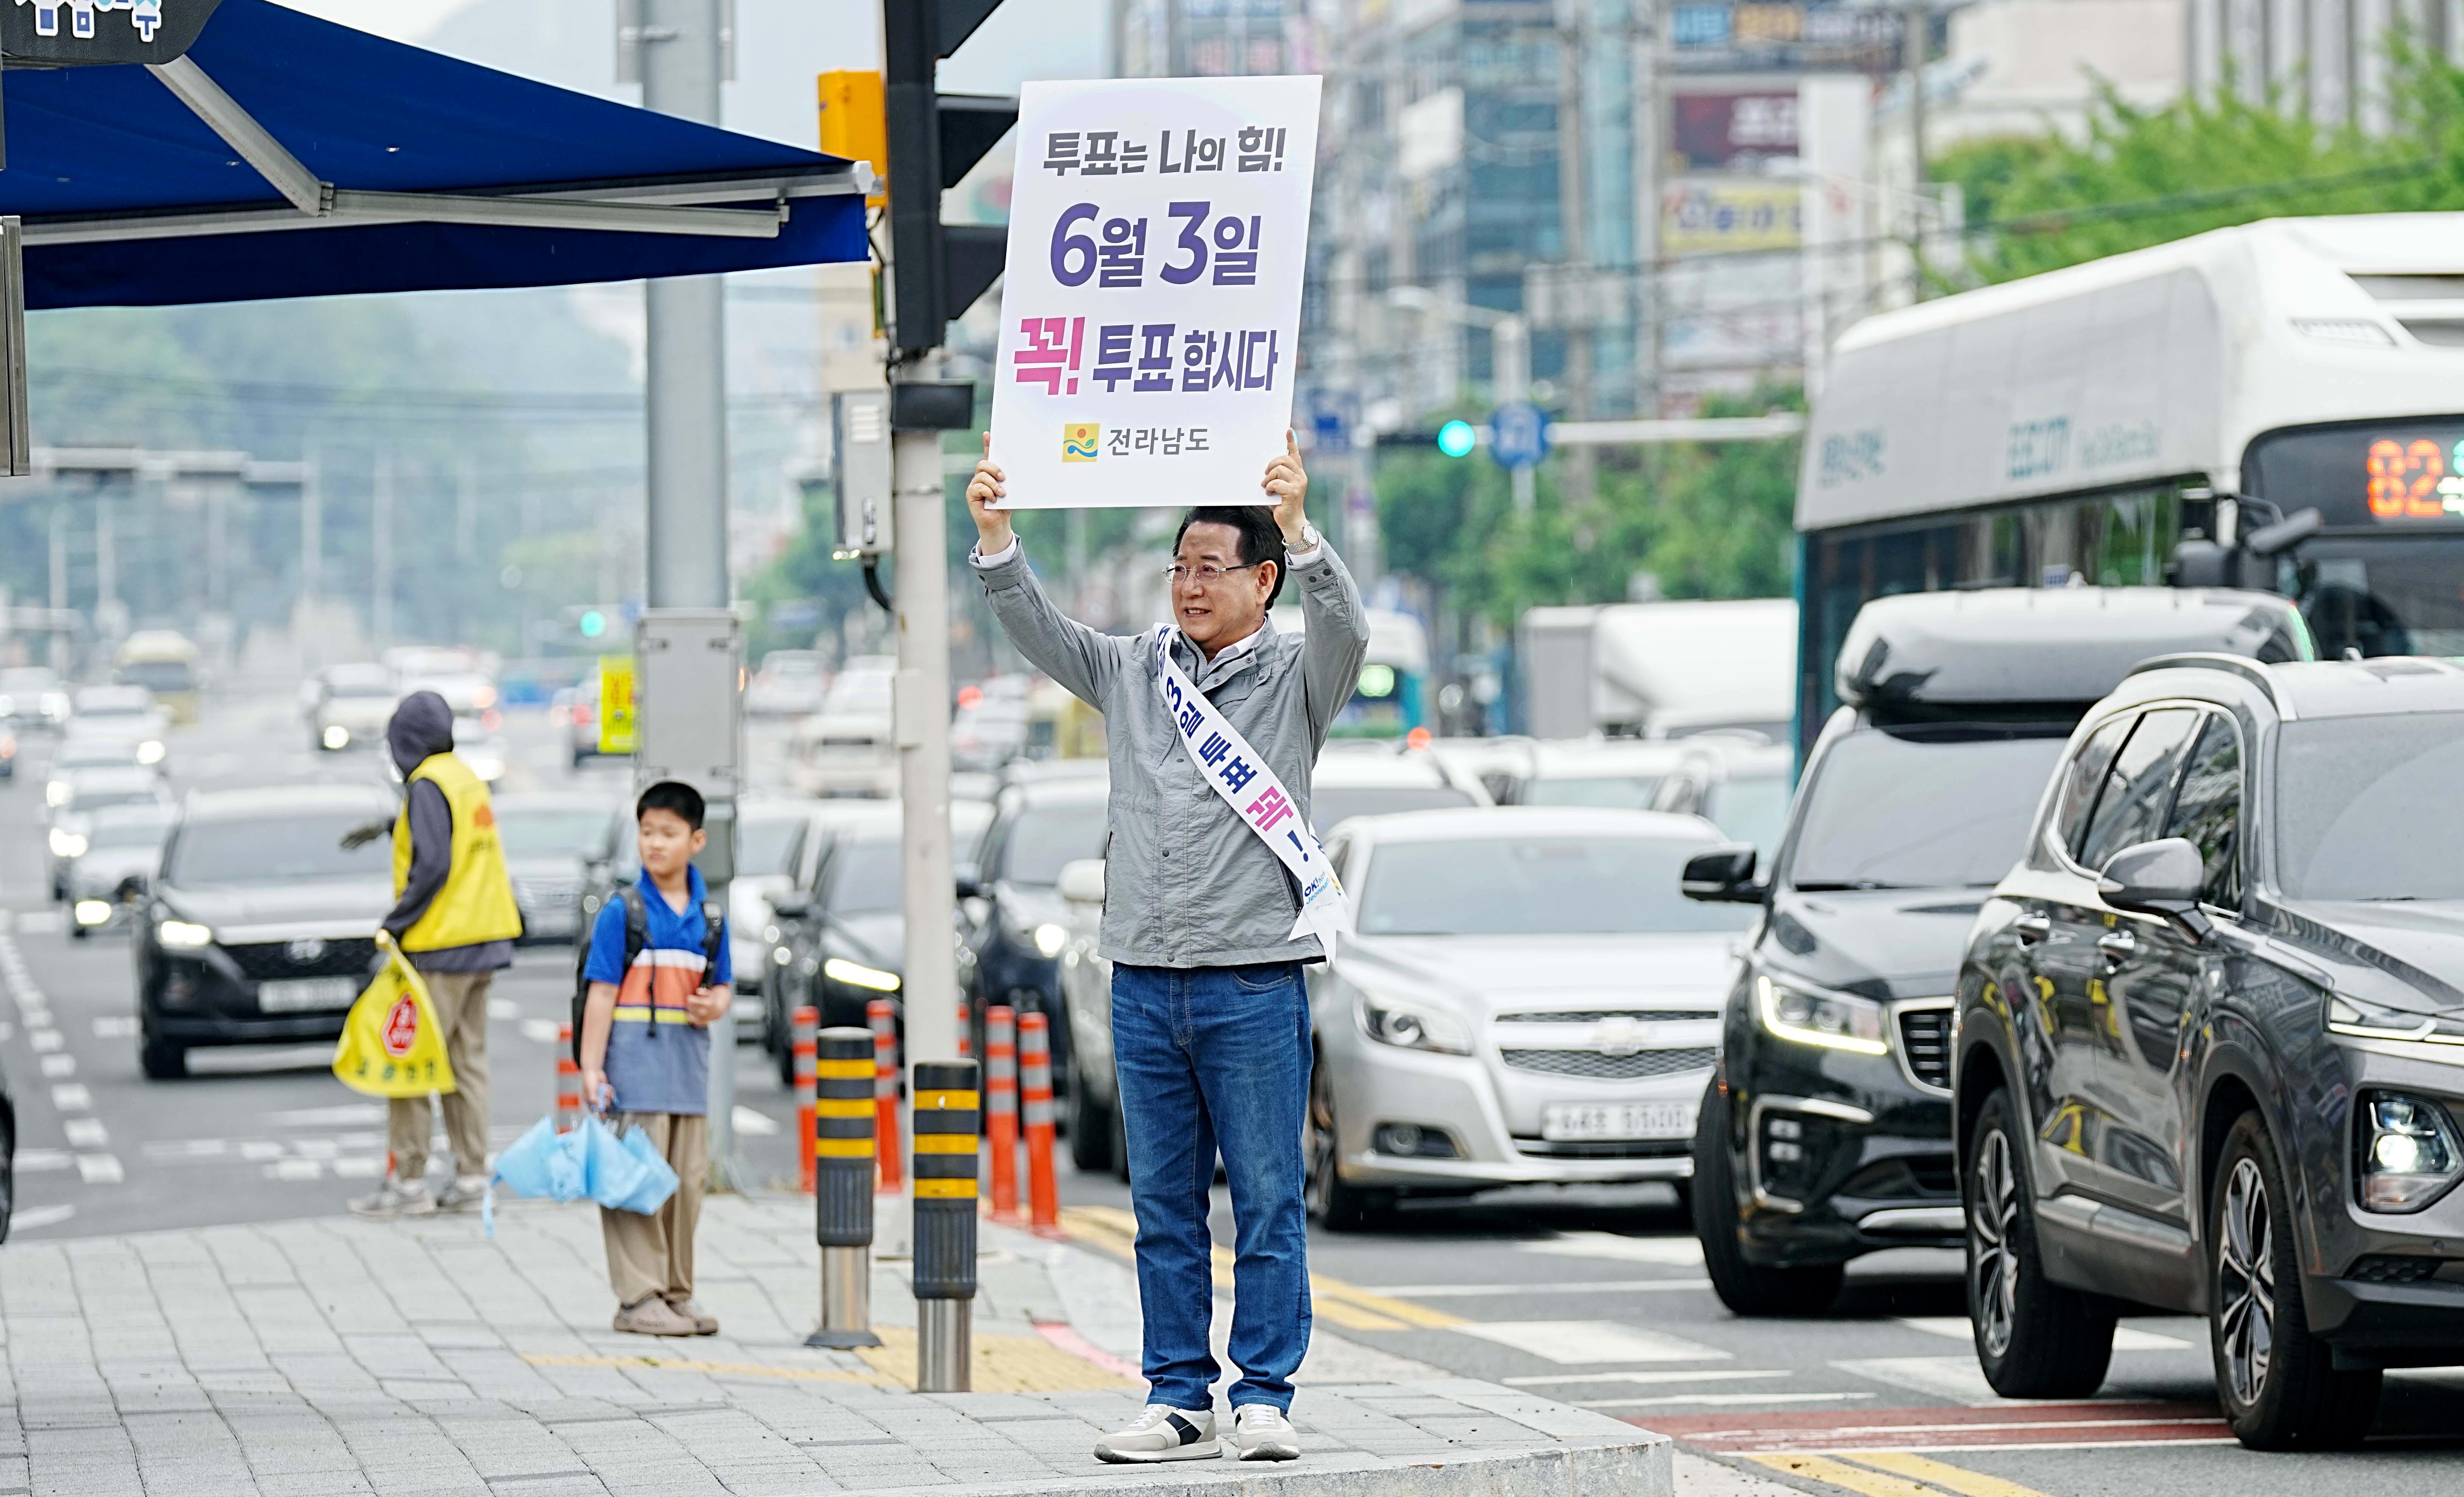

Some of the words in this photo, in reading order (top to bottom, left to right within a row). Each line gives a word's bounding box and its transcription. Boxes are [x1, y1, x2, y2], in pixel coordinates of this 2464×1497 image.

[1043, 131, 1148, 177] 투표는
[1159, 129, 1226, 174] 나의
[1238, 126, 1286, 173] 힘!
[1050, 202, 1148, 288] 6월
[1159, 201, 1261, 286] 3일
[1014, 316, 1086, 395] 꼭!
[1092, 323, 1176, 393] 투표
[1181, 329, 1279, 392] 합시다
[1107, 427, 1209, 456] 전라남도
[2367, 440, 2444, 517] 02
[1167, 676, 1205, 739] 3일
[1198, 731, 1258, 795] 투표
[1304, 877, 1319, 897] OK!
